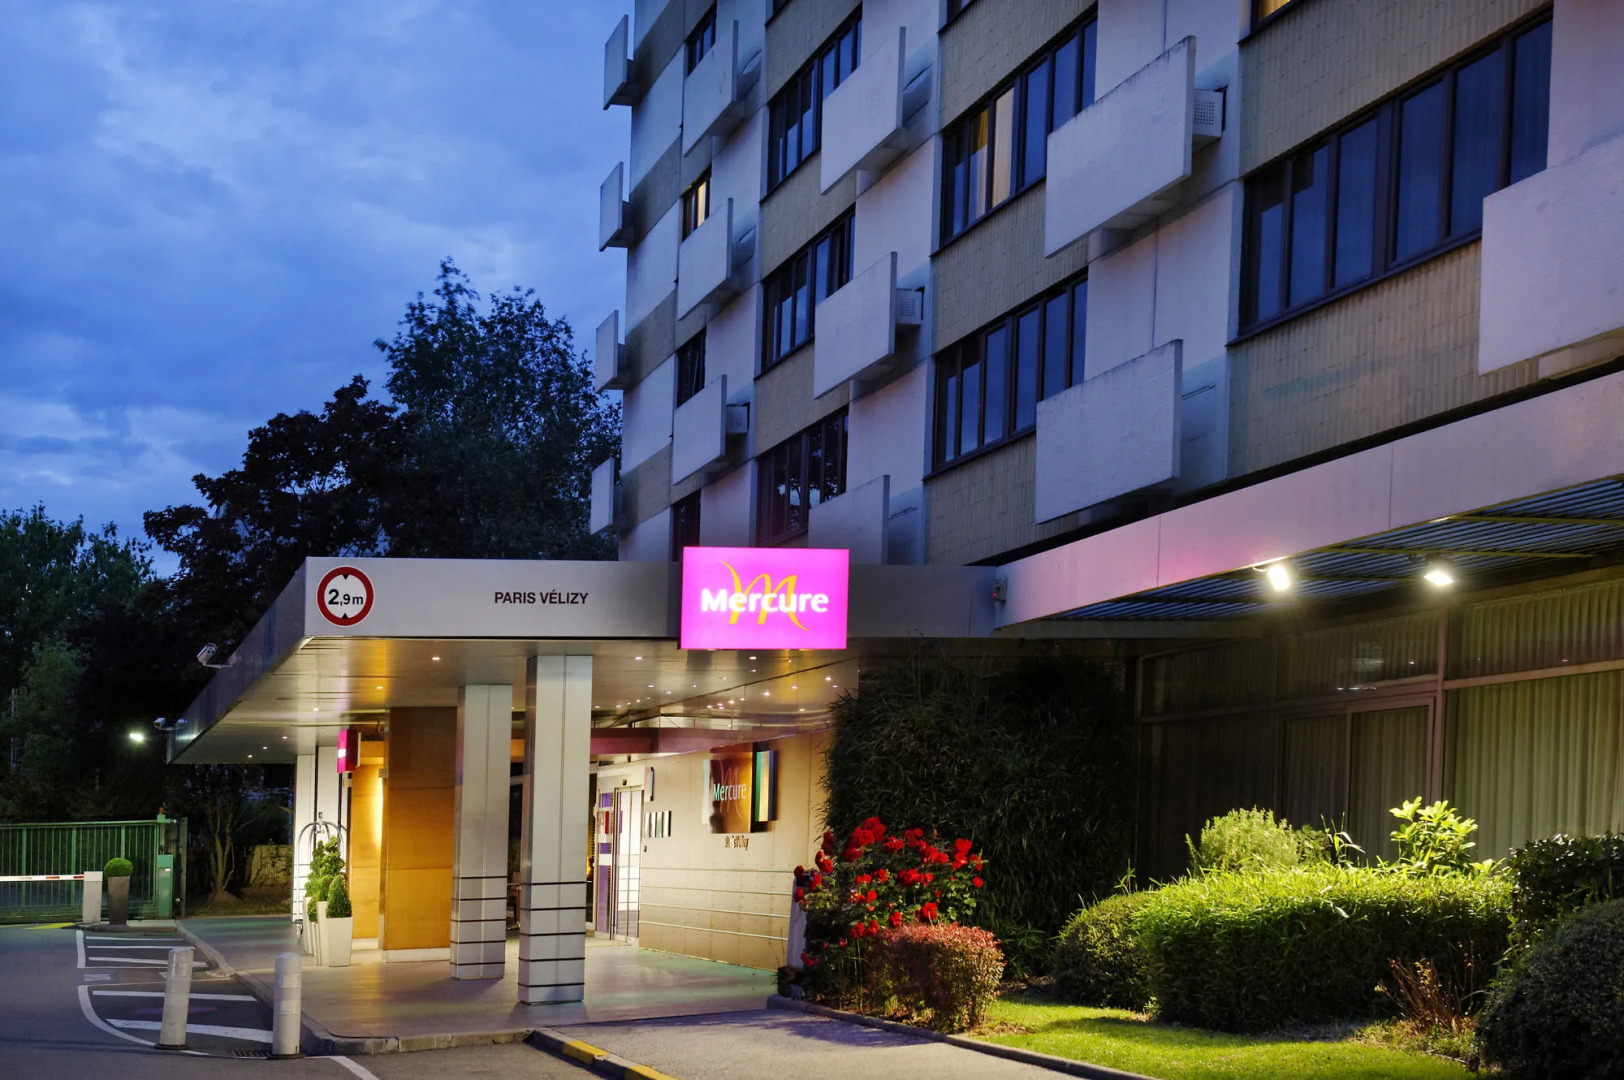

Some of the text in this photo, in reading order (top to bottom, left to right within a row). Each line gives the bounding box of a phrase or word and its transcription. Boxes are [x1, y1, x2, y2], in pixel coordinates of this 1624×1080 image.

[494, 588, 589, 605] PARIS VÉLIZY
[700, 588, 829, 613] Mercure
[712, 782, 747, 802] Mercure
